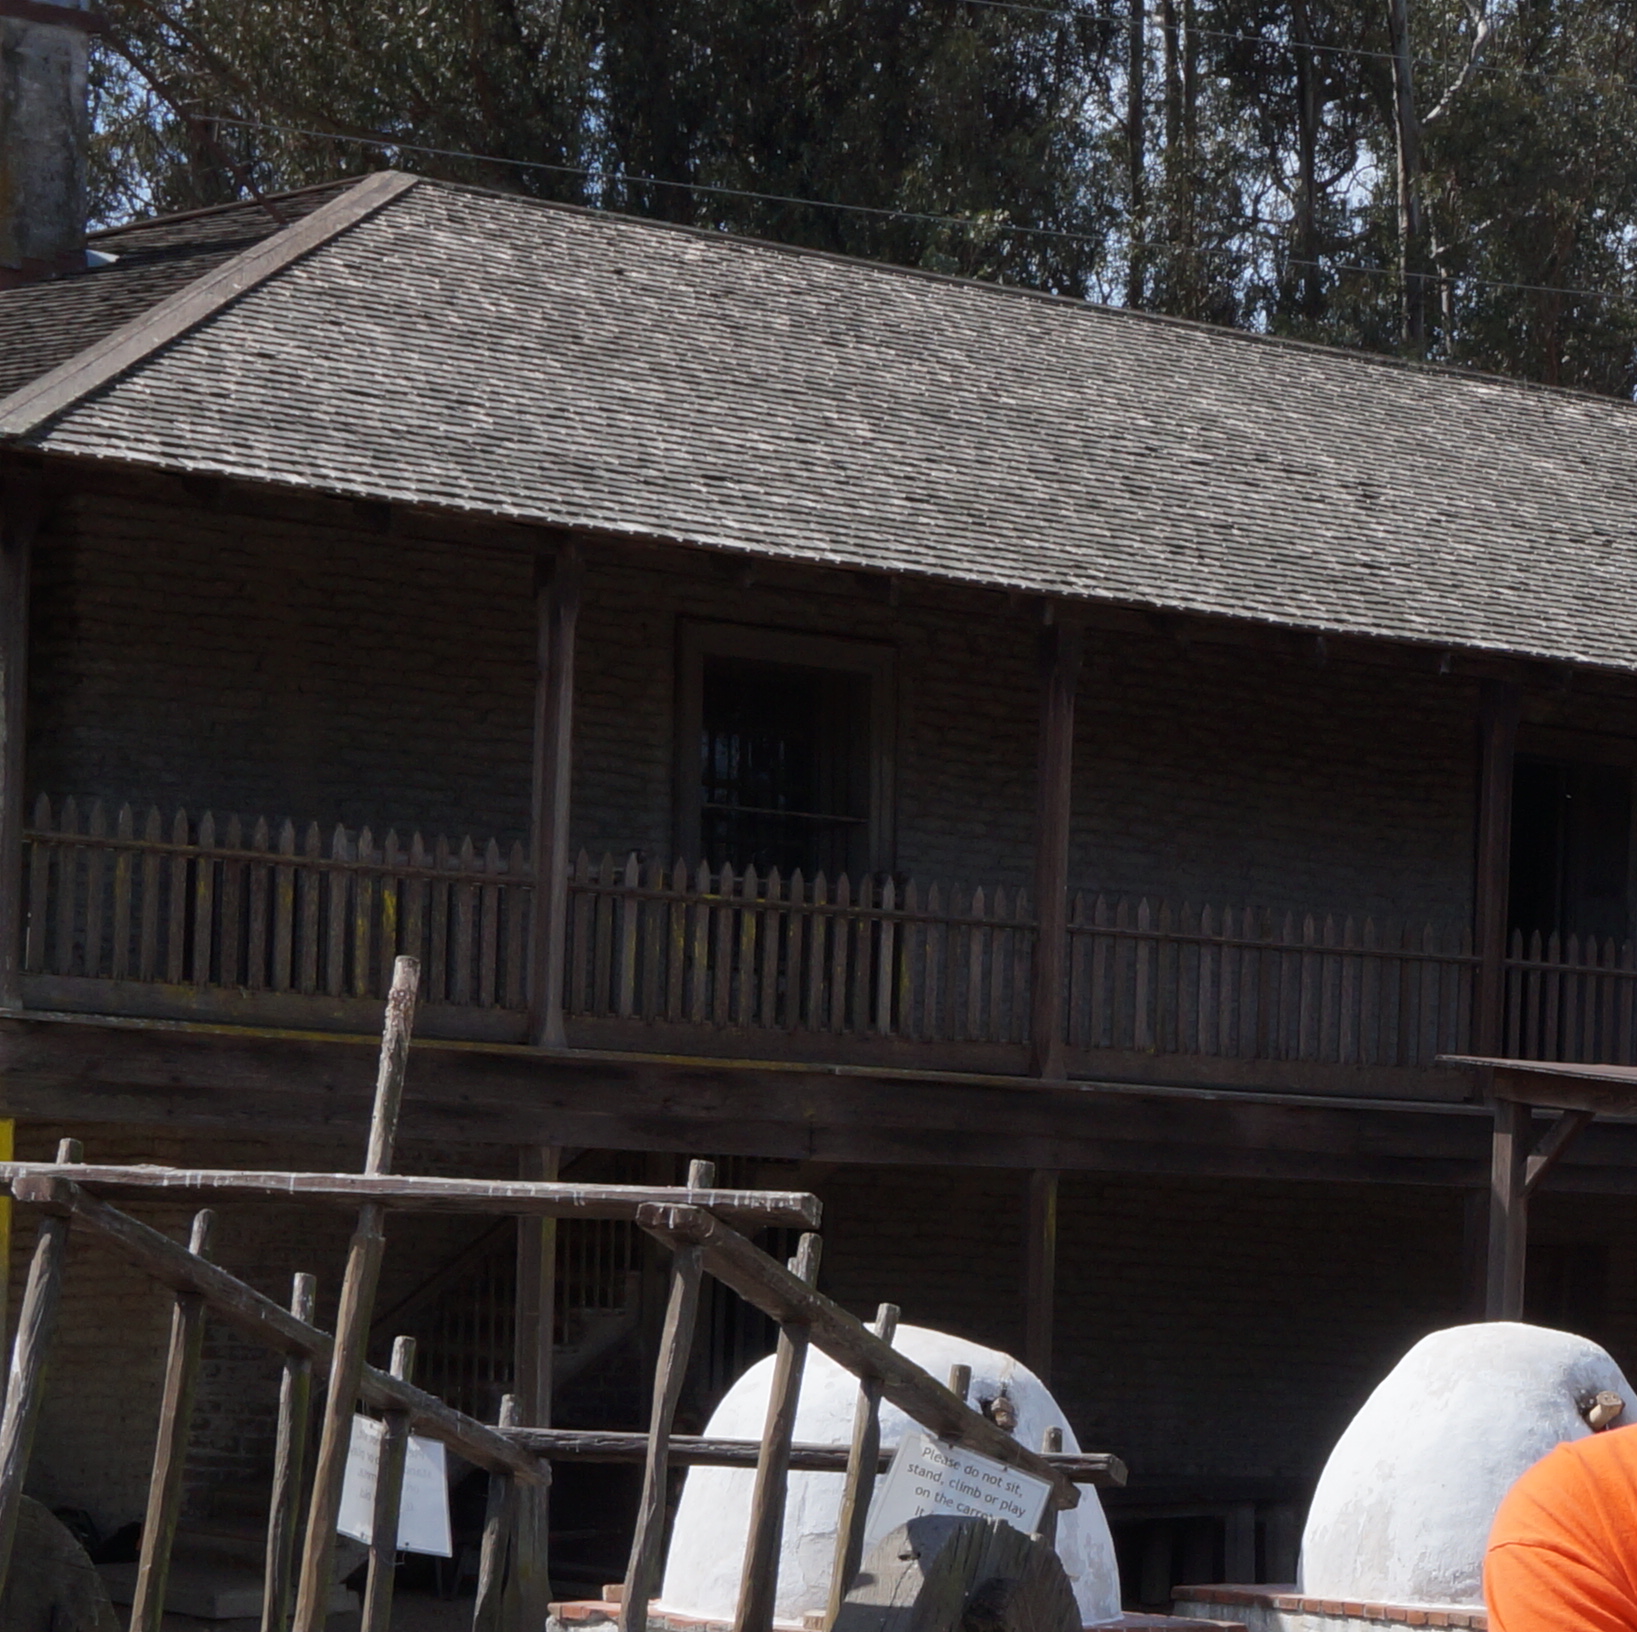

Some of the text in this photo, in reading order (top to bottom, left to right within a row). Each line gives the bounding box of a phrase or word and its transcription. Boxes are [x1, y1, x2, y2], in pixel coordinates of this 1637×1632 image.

[921, 1446, 1023, 1498] Please do not sit,
[907, 1463, 1026, 1518] stand, climb or play
[915, 1486, 930, 1498] on
[934, 1491, 954, 1507] the
[914, 1505, 924, 1516] It
